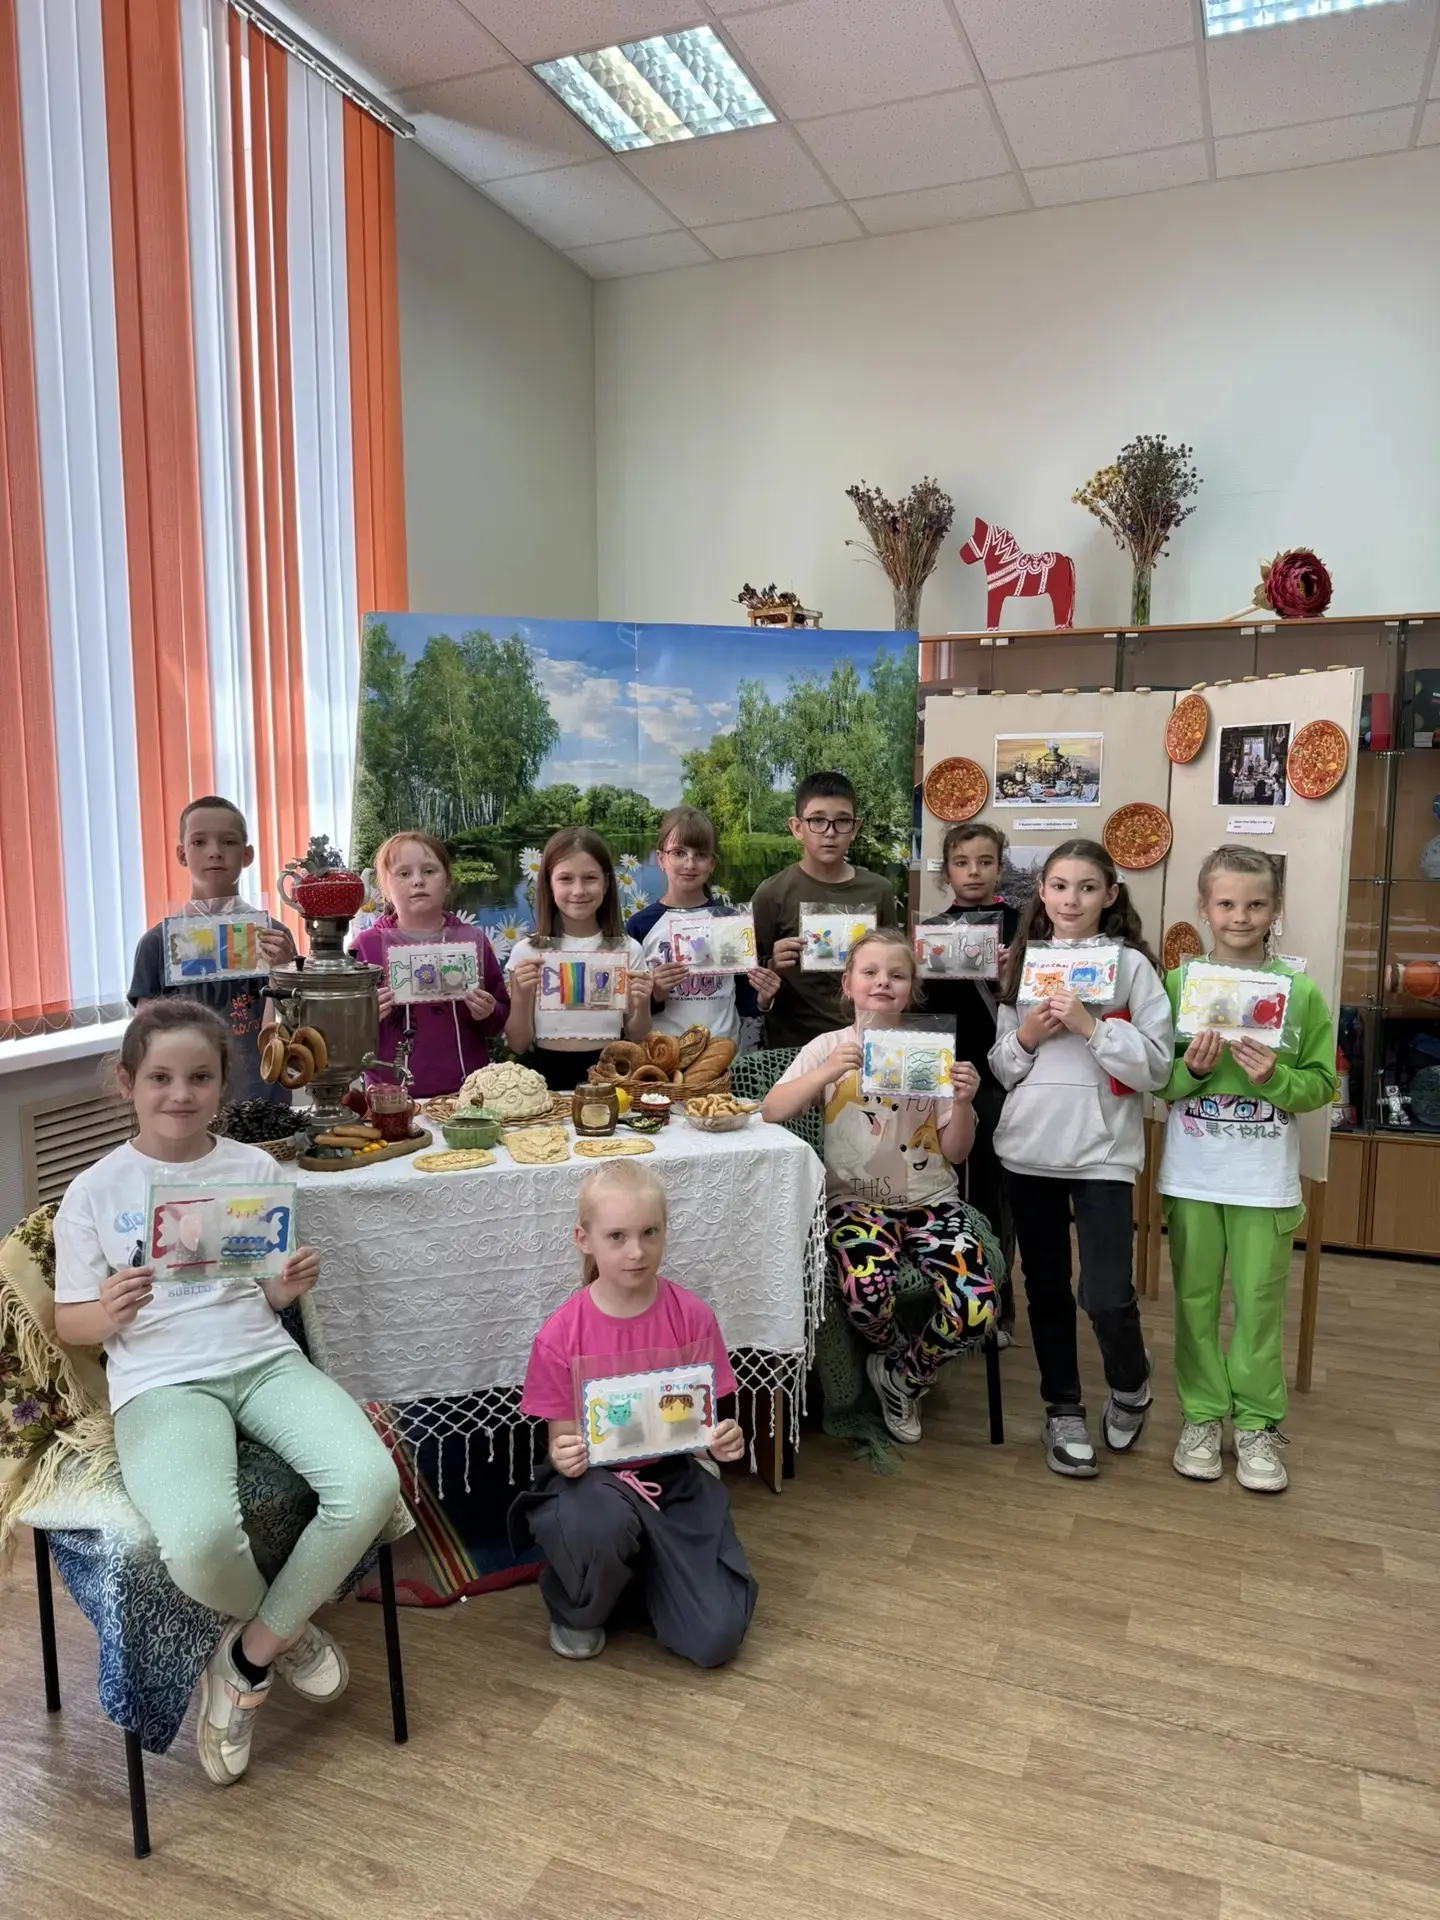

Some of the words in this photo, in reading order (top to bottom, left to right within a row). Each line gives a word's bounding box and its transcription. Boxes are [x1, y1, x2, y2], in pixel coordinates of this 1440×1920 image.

[1206, 1121, 1281, 1140] 早くやれよ
[850, 1175, 891, 1198] THIS
